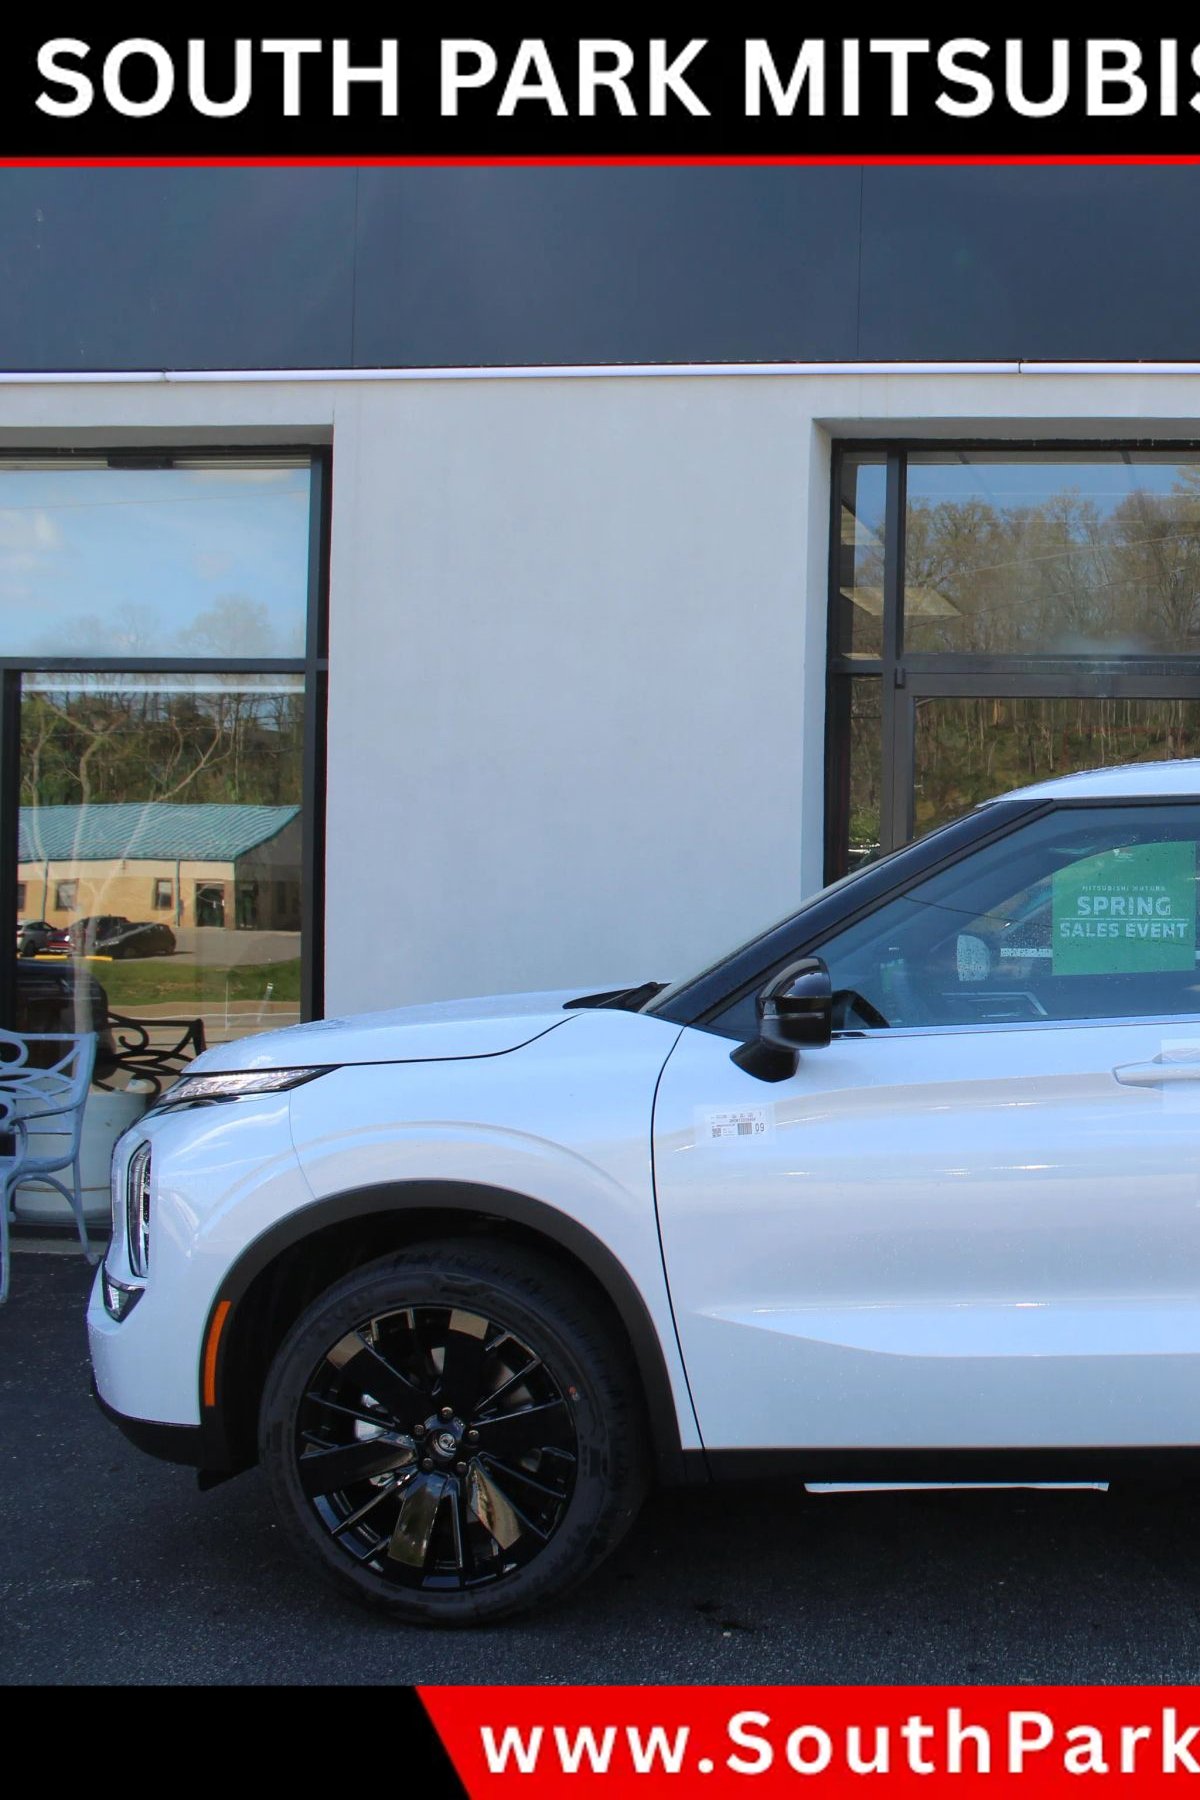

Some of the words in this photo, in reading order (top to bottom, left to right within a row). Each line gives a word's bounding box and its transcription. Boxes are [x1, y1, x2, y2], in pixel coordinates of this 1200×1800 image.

[1077, 896, 1171, 916] SPRING
[1060, 922, 1120, 938] SALES
[1125, 922, 1188, 938] EVENT
